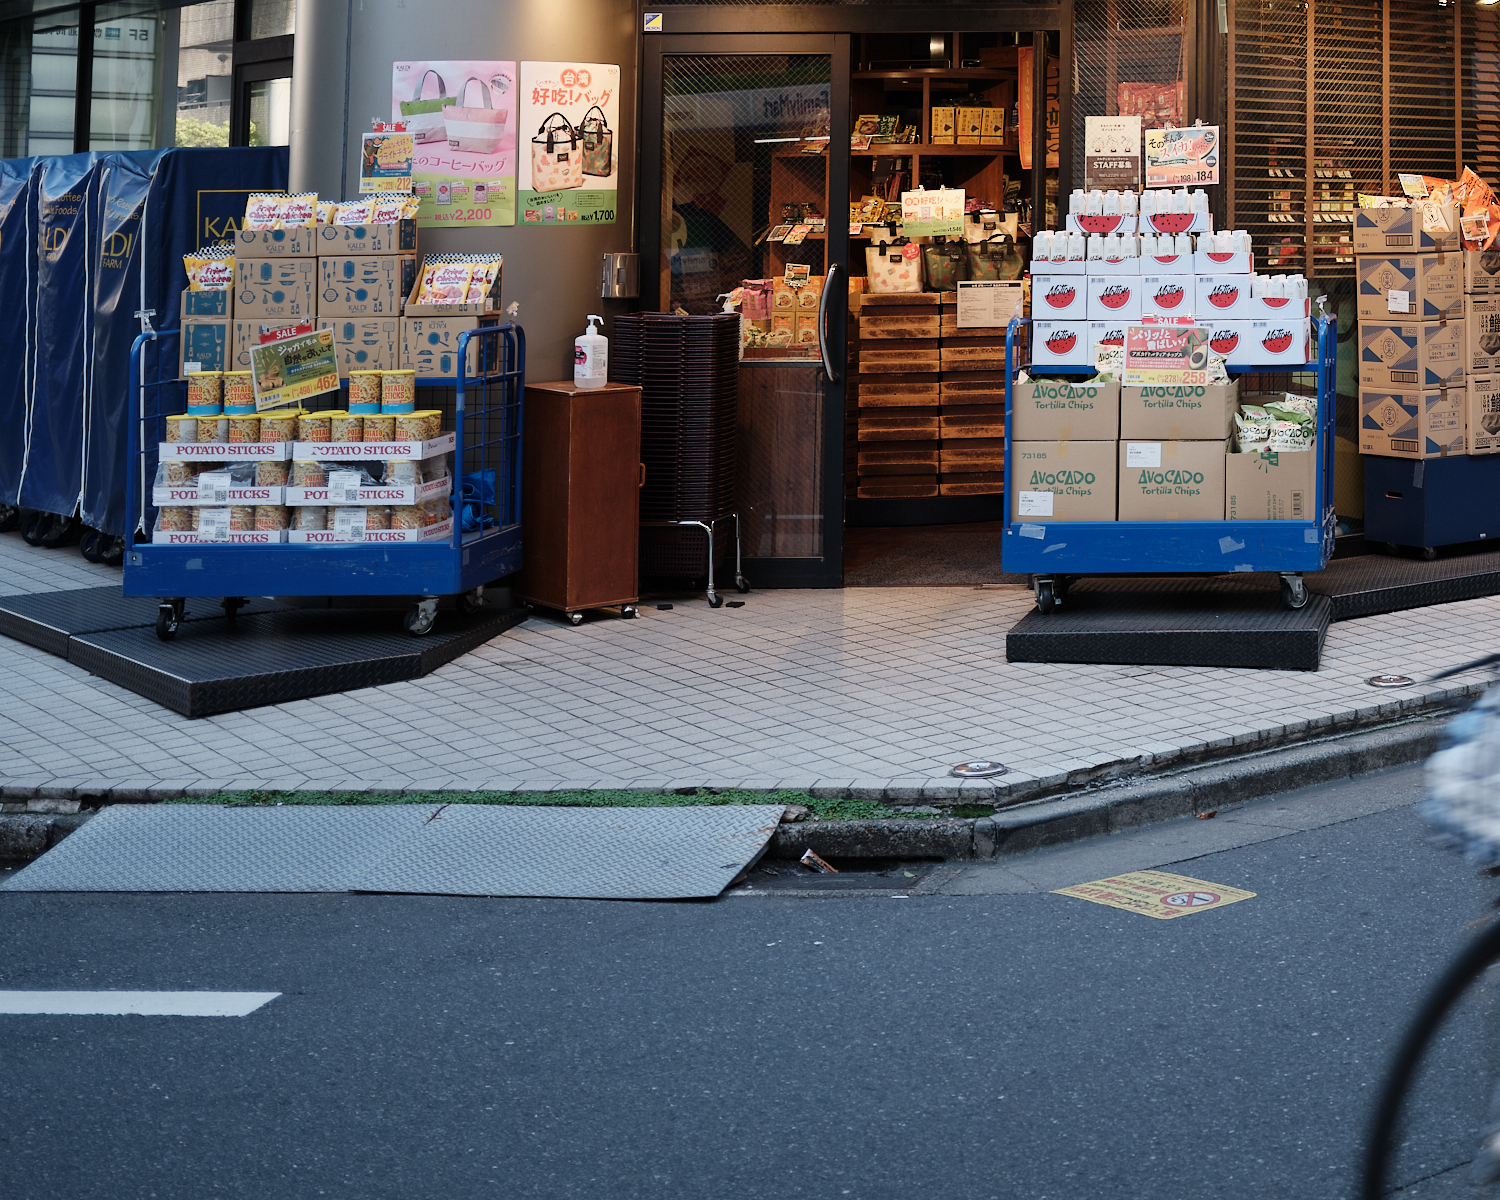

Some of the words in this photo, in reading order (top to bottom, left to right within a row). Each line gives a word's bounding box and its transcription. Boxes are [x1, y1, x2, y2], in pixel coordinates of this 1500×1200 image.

[563, 72, 589, 86] 台湾
[382, 124, 396, 132] SALE
[287, 203, 307, 212] Fried
[377, 208, 397, 217] Fried
[280, 209, 313, 220] Chicken
[102, 232, 133, 258] LDI
[205, 266, 227, 275] Fried
[442, 267, 465, 276] Fried
[198, 272, 232, 283] Chicken
[435, 274, 467, 282] Chicken
[1157, 317, 1179, 326] SALE
[276, 327, 297, 340] SALE
[277, 338, 318, 356] ジャガイモの
[384, 384, 405, 392] POTATO
[1031, 384, 1098, 400] AVOCADO
[1140, 386, 1206, 398] AVOCADO
[384, 391, 405, 400] STICKS
[1035, 400, 1066, 410] Tortilla
[1067, 400, 1094, 411] Chips
[1143, 399, 1174, 409] Tortilla
[1176, 399, 1202, 410] Chips
[261, 430, 281, 438] POTATO
[176, 445, 226, 455] POTATO
[228, 445, 275, 455] STICKS
[311, 445, 362, 455] POTATO
[364, 445, 411, 455] STICKS
[1030, 470, 1096, 486] AVOCADO
[1138, 469, 1205, 485] AVOCADO
[169, 490, 198, 500] POT
[303, 490, 328, 500] POT
[1066, 486, 1092, 497] Chips
[1141, 486, 1172, 495] Tortilla
[1174, 486, 1201, 497] Chips
[169, 534, 199, 543] POT
[306, 532, 336, 542] POTA
